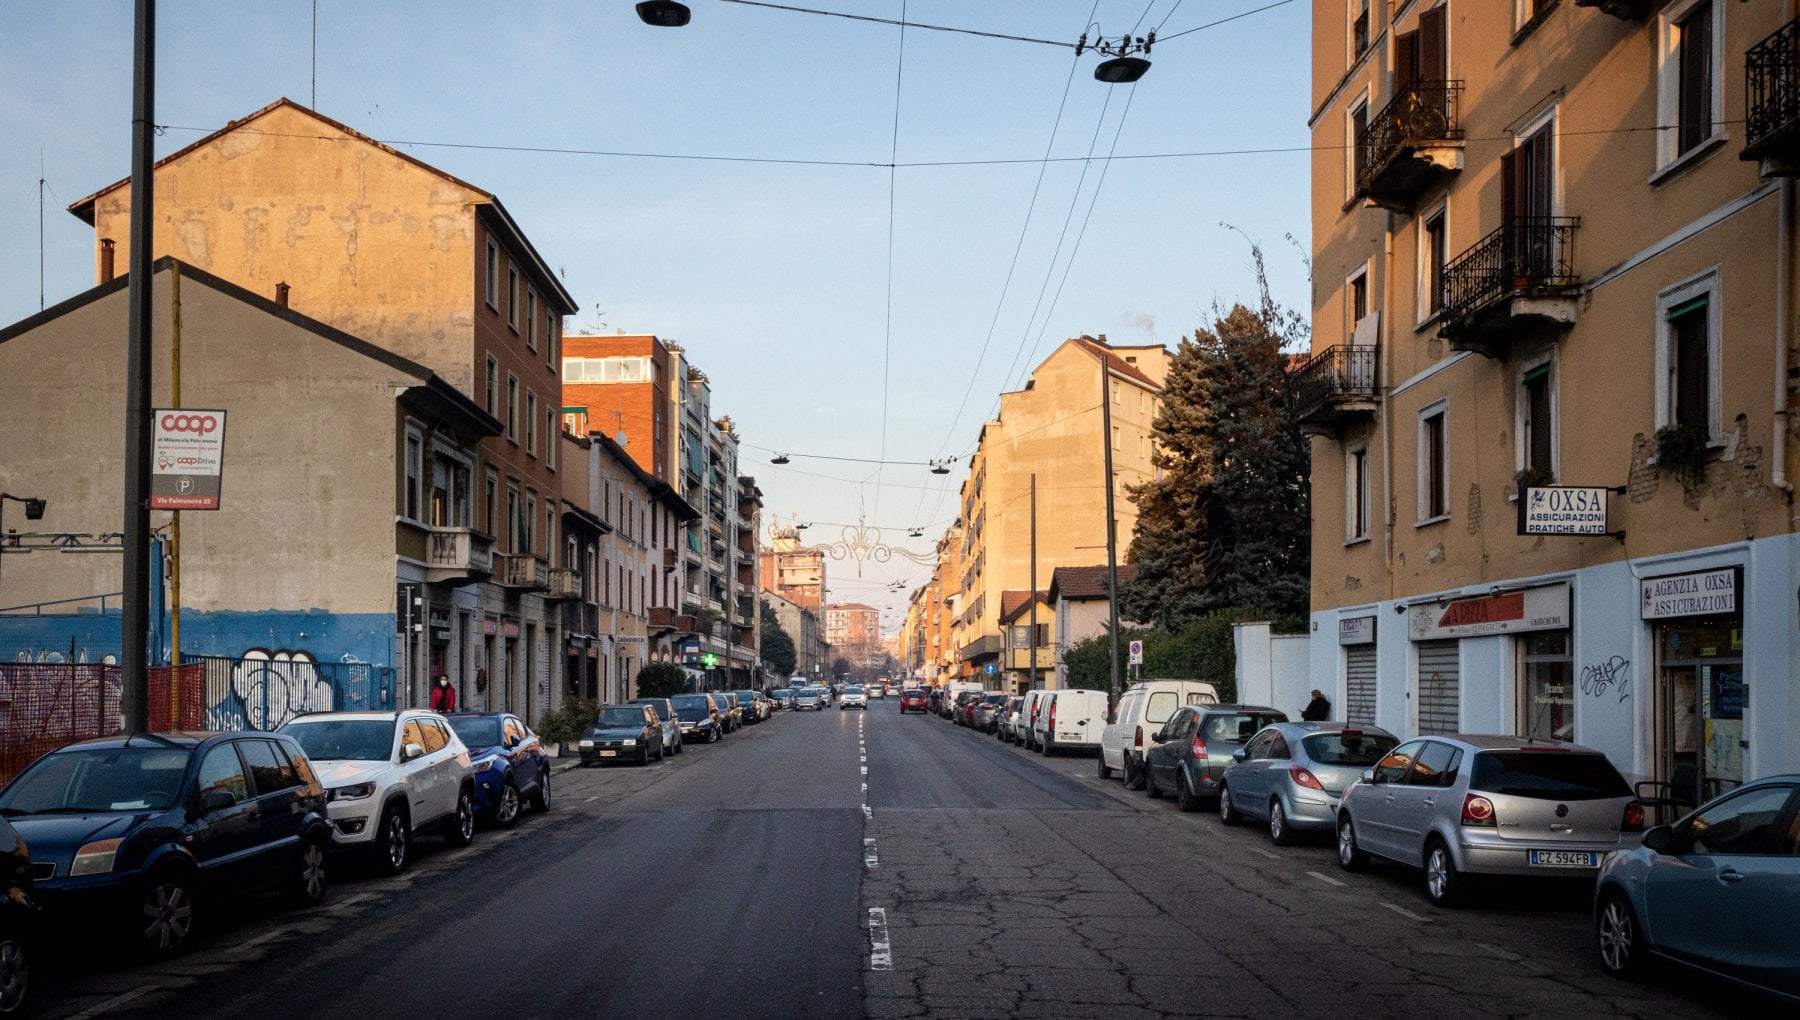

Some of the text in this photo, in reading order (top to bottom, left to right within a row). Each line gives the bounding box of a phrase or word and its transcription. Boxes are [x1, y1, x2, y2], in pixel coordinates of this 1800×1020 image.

[161, 414, 217, 437] coop
[1549, 490, 1601, 512] OXSA
[1529, 524, 1604, 532] PRATICHE AUTO
[1530, 514, 1604, 522] ASSICURAZIONI
[1654, 574, 1732, 596] AGENZIA OXSA
[1461, 602, 1488, 624] PIZZA
[1654, 594, 1734, 616] ASSICURAZIONI
[1538, 852, 1590, 864] CZ 594FB
